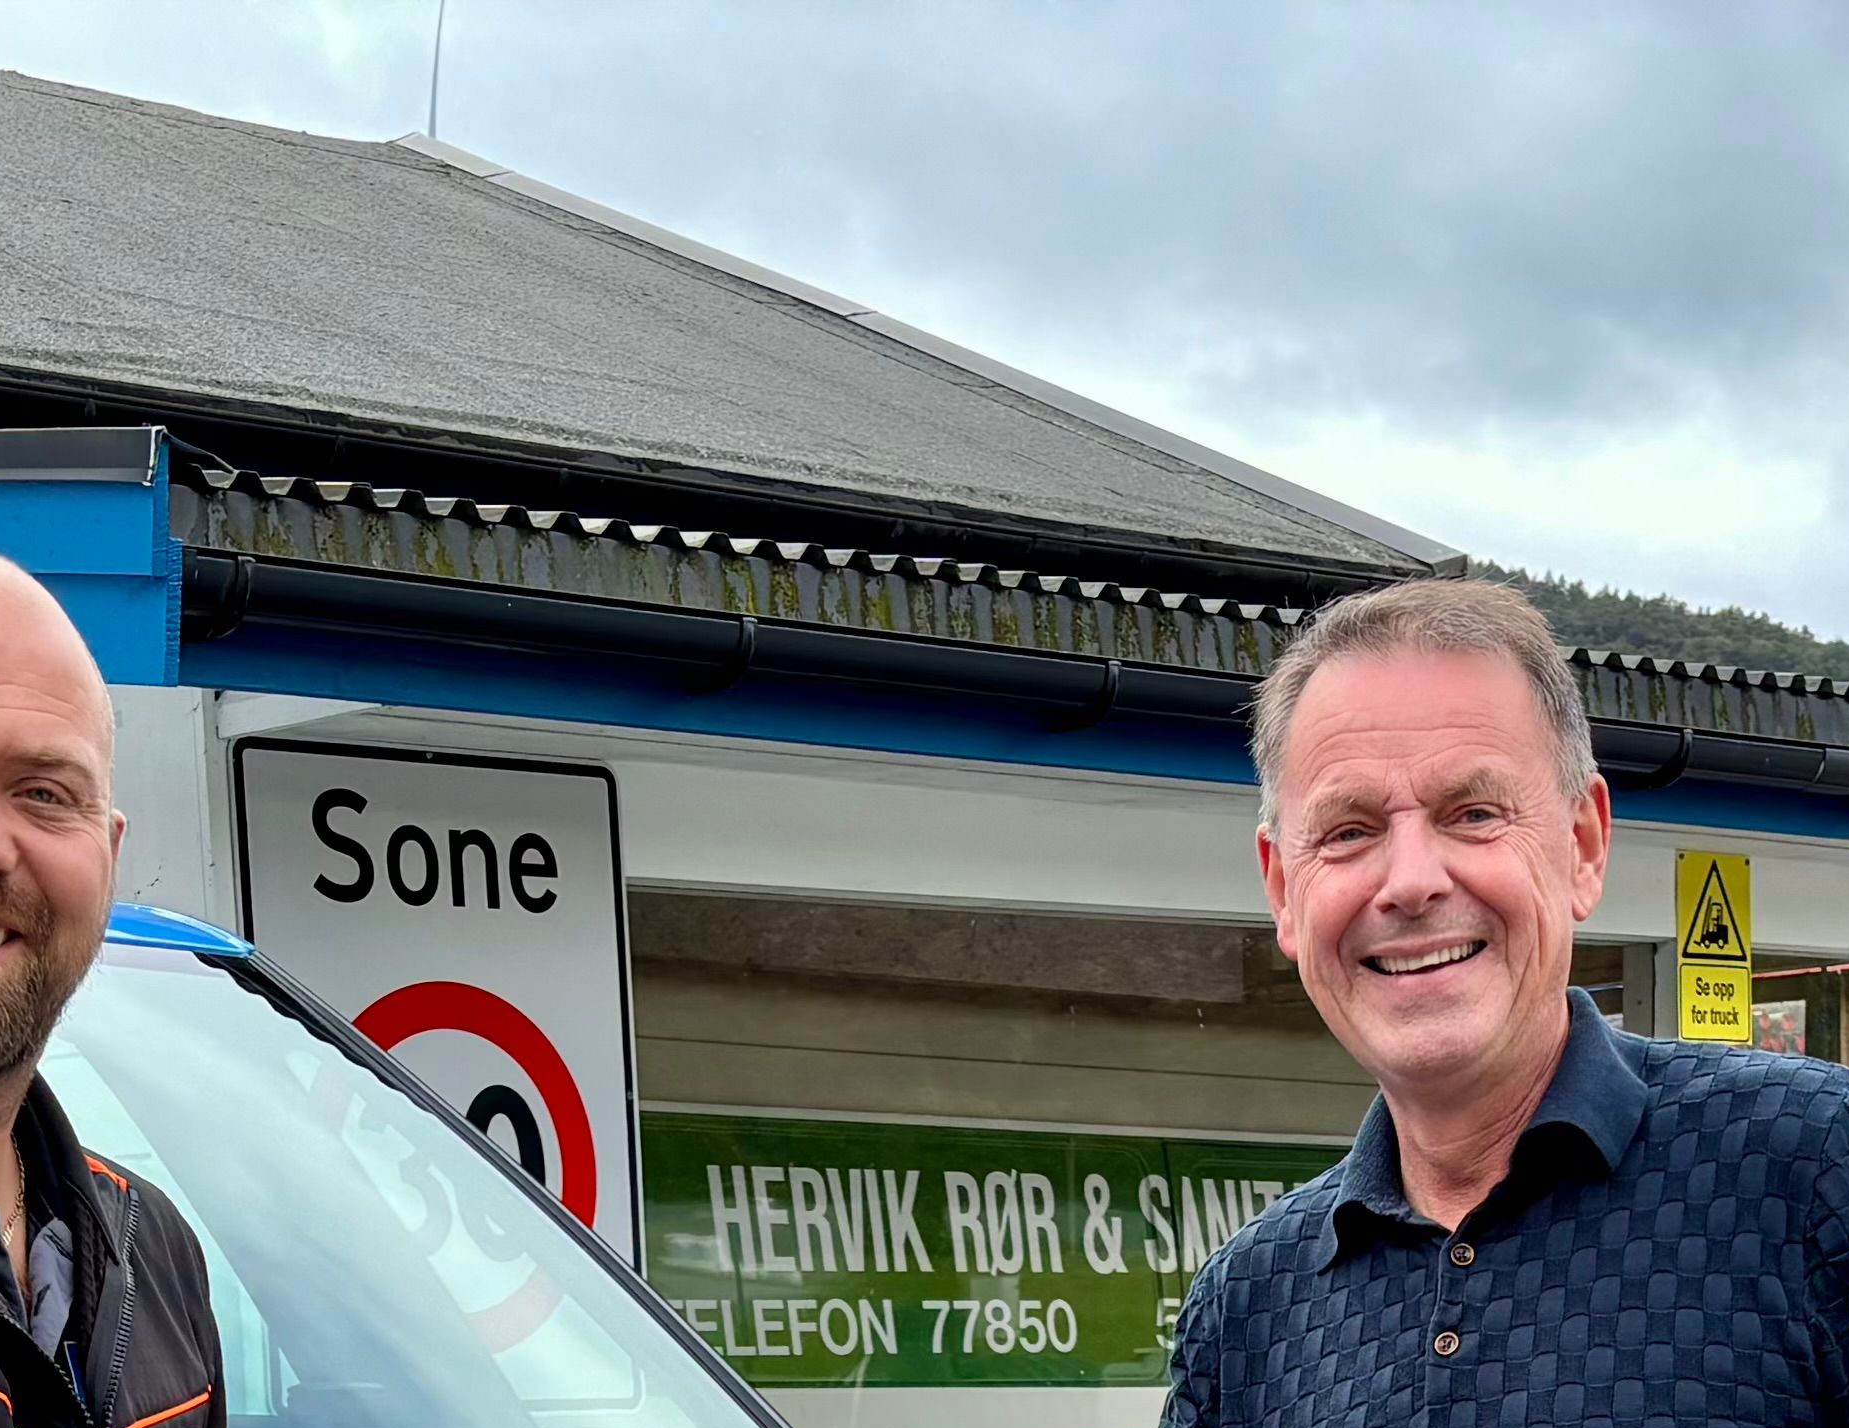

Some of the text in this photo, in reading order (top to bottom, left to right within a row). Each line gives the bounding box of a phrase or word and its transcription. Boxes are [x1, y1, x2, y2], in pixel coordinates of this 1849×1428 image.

[311, 788, 559, 913] Sone
[1691, 1004, 1740, 1026] for truck
[1695, 977, 1735, 1001] Se opp
[706, 1164, 1312, 1276] HERVIK RØR & SAN
[668, 1298, 898, 1357] ELEFON
[922, 1298, 1078, 1356] 77850
